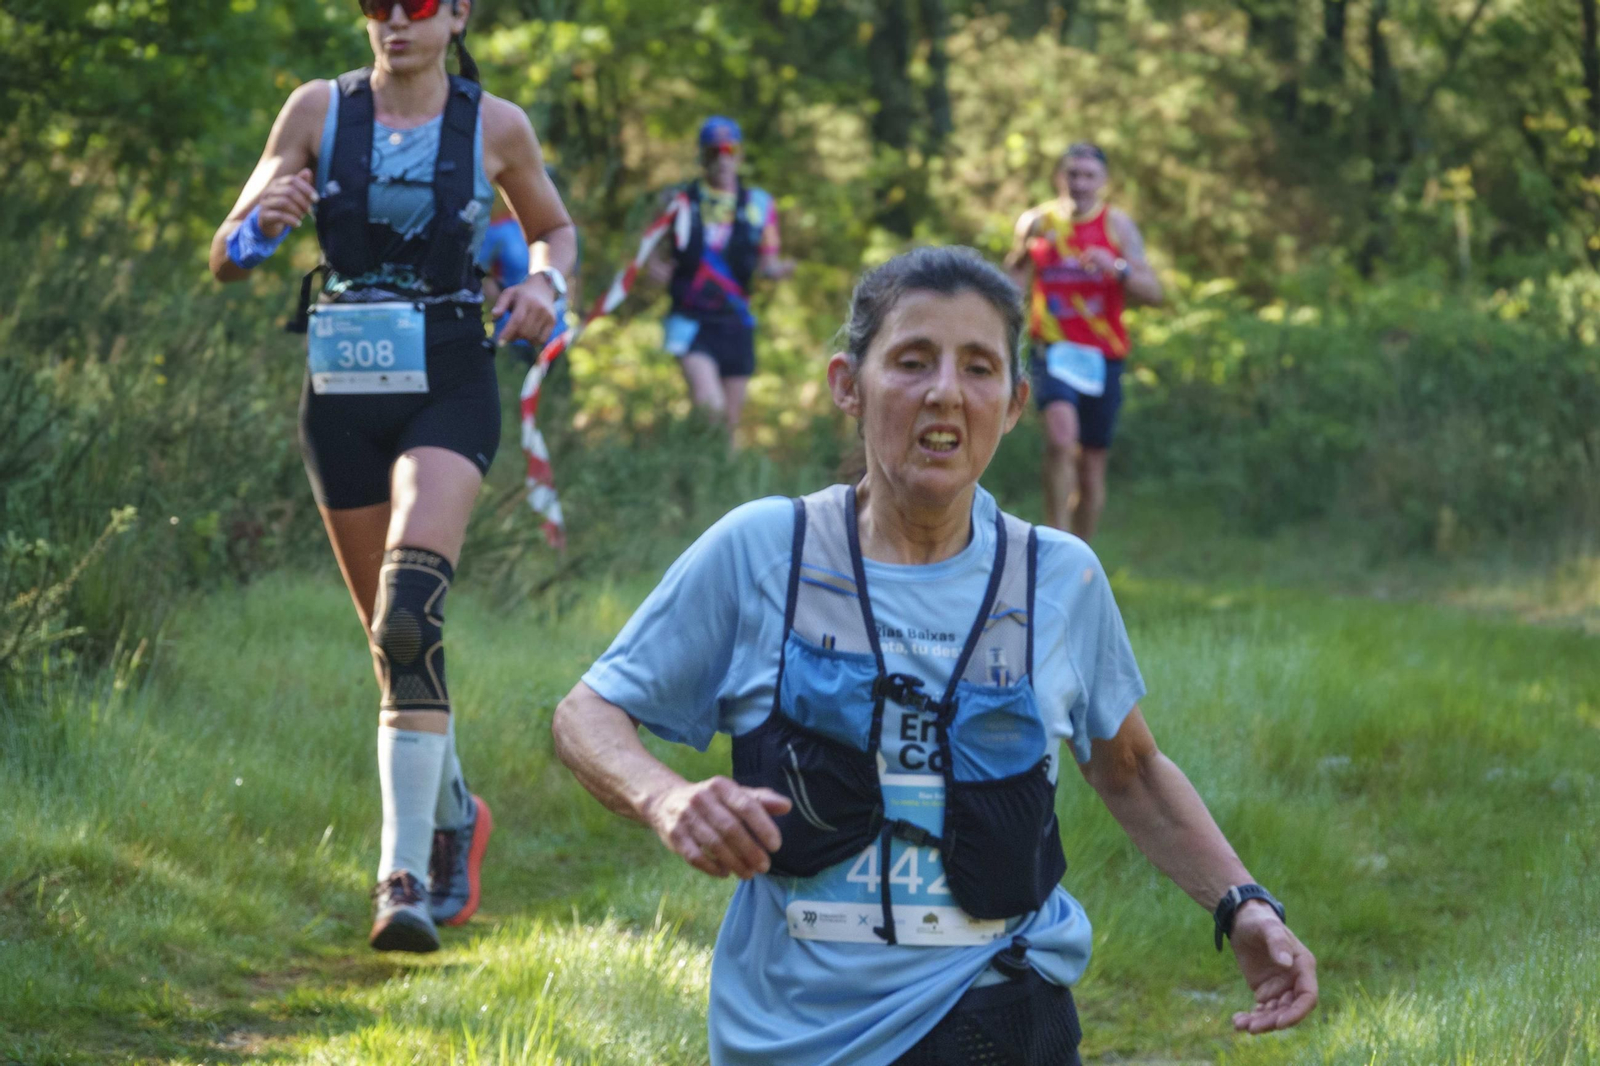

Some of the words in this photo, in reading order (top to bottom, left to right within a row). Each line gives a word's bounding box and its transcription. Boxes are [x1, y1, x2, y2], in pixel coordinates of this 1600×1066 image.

[338, 340, 395, 368] 308
[907, 628, 956, 641] Baixas
[847, 844, 952, 895] 442
